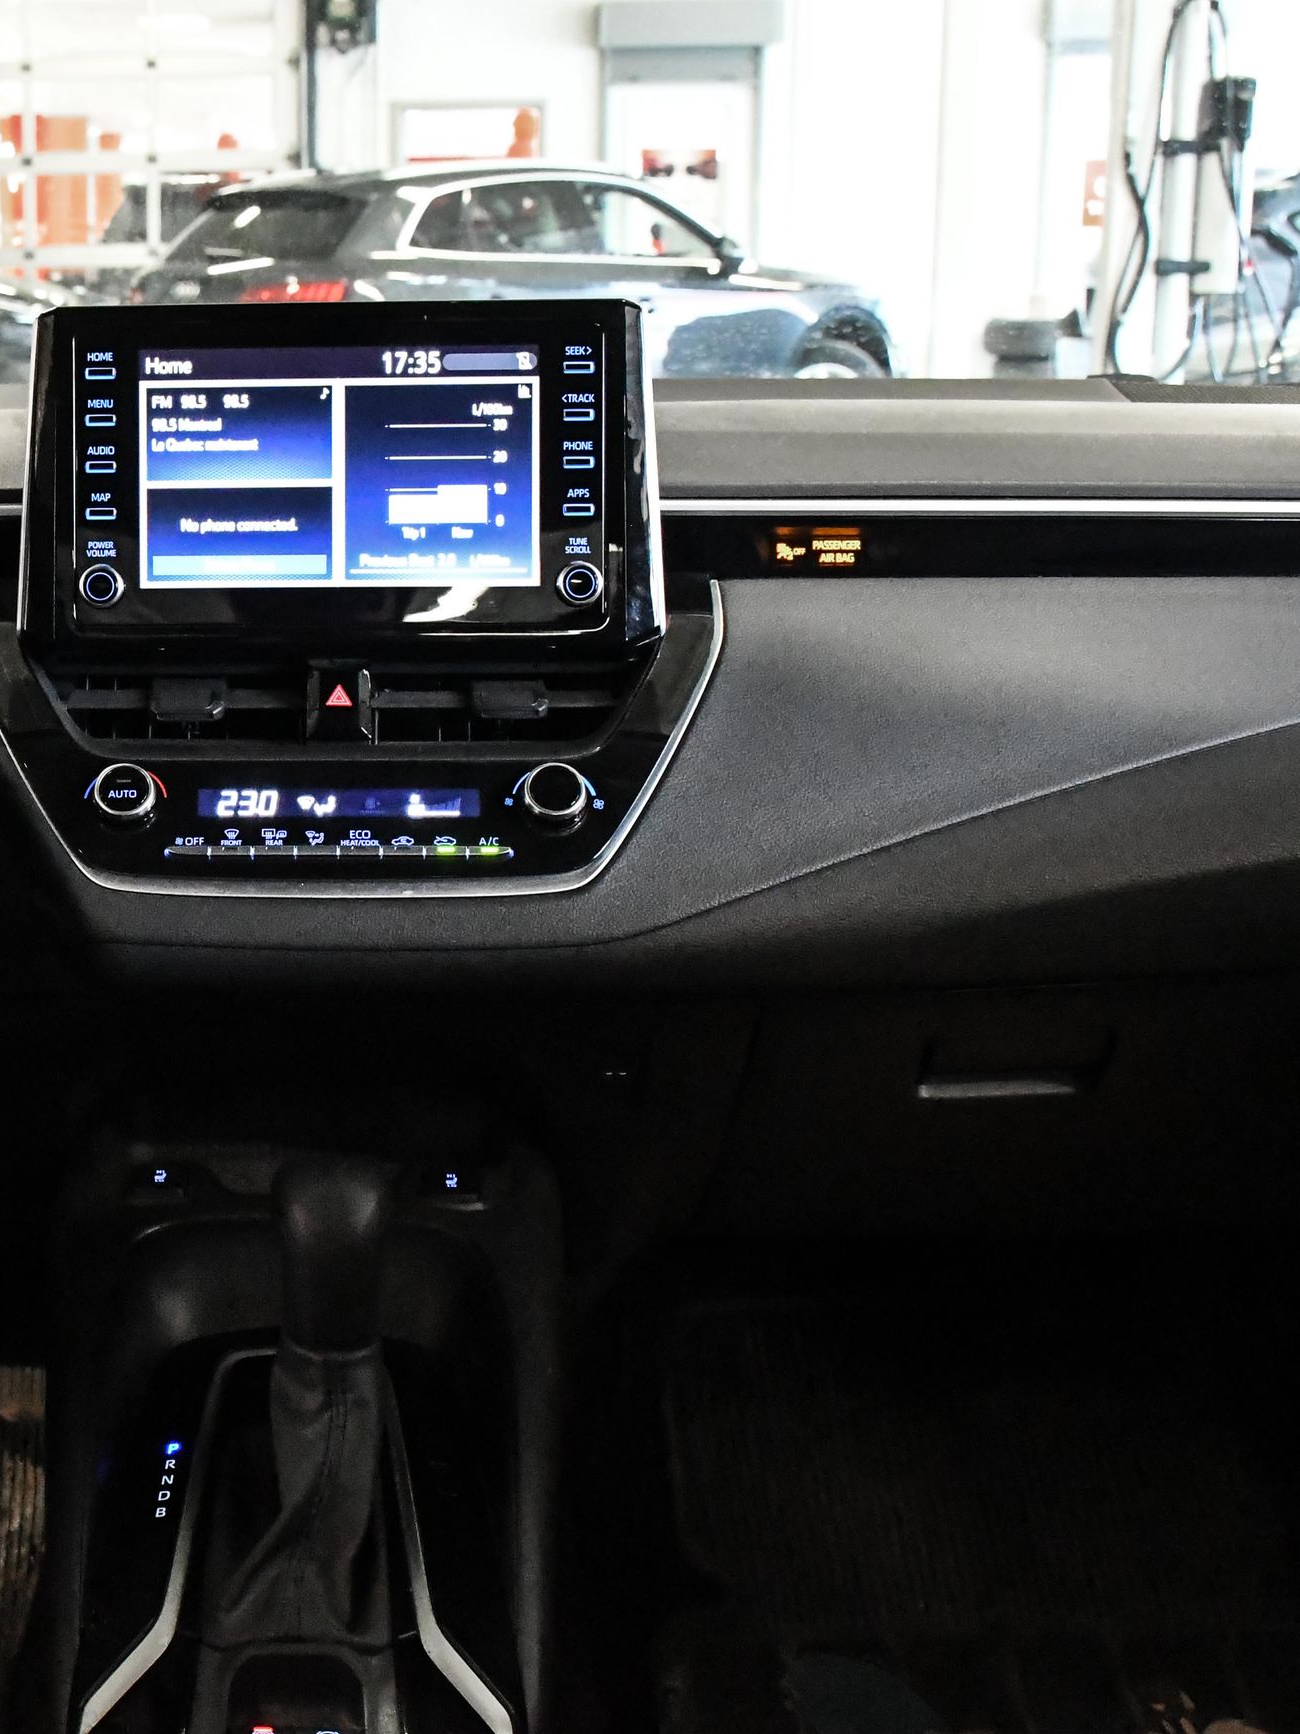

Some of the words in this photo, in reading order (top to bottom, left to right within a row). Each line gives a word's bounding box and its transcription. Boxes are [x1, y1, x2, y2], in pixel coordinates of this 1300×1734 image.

[87, 352, 114, 362] HOME
[145, 357, 193, 375] Home
[382, 350, 442, 375] 17:35
[87, 399, 114, 409] MENU
[151, 395, 173, 409] FM
[87, 446, 115, 456] AUDIO
[563, 441, 594, 451] PHONE
[91, 493, 111, 502] MAP
[567, 488, 590, 498] APPS
[88, 541, 114, 549] POWER
[568, 537, 588, 545] TUNE
[812, 540, 861, 551] PASSENGER
[86, 549, 117, 557] VOLUME
[565, 546, 591, 554] SCROLL
[819, 552, 835, 563] AIR
[835, 552, 855, 563] BAG
[108, 789, 137, 798] AUTO
[349, 830, 371, 840] ECO
[185, 837, 205, 846] OFF
[479, 836, 499, 847] A/C
[167, 1443, 180, 1455] P
[165, 1459, 176, 1470] R
[161, 1475, 174, 1485] N
[158, 1491, 170, 1501] D
[155, 1507, 166, 1518] B
